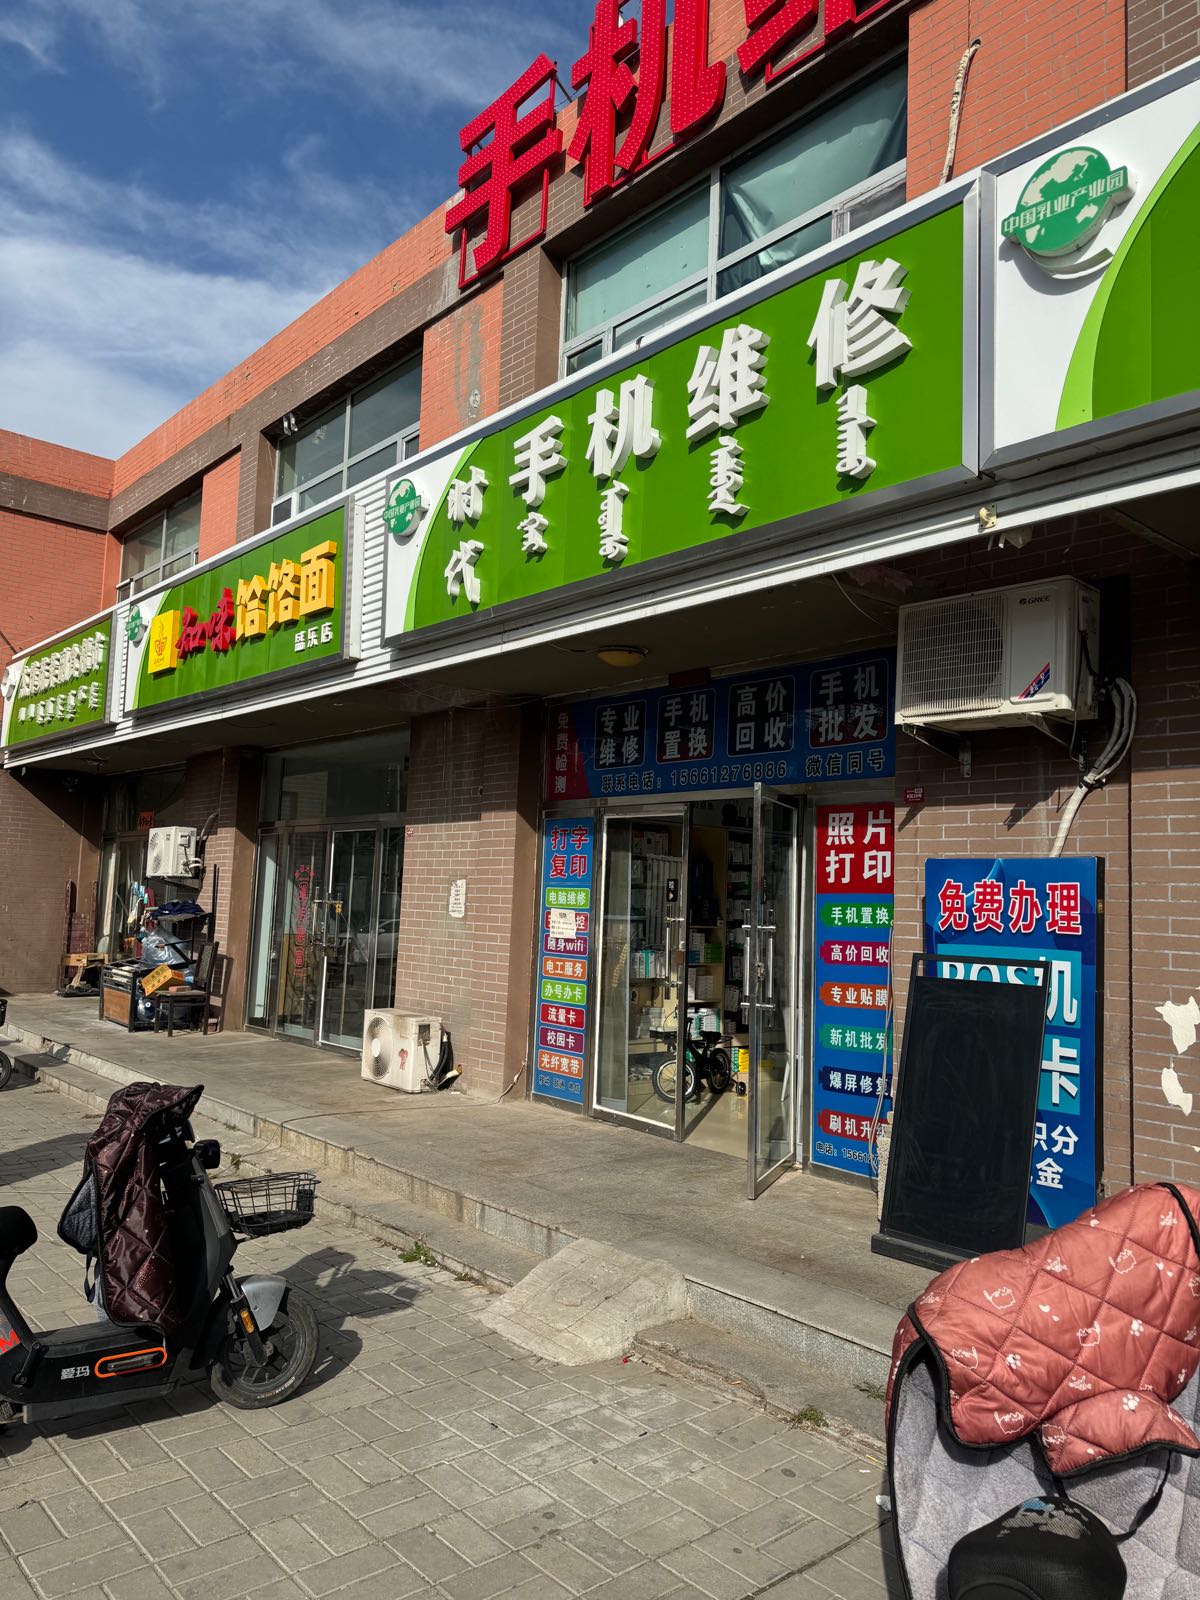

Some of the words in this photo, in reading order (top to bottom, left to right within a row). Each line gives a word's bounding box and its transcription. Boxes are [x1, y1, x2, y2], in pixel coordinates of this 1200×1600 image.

[1003, 170, 1124, 233] 中国乳业产业园
[508, 257, 913, 508] 手机维修
[444, 465, 490, 604] 时代
[736, 681, 788, 717] 高价
[818, 665, 880, 705] 手机
[601, 706, 640, 735] 专业
[664, 694, 709, 728] 手机
[818, 704, 879, 743] 批发
[663, 726, 709, 760] 置换
[735, 717, 787, 751] 回收
[553, 712, 570, 794] 免费检测
[599, 735, 640, 767] 维修
[805, 748, 886, 777] 微信同号
[551, 825, 589, 850] 打字
[826, 811, 893, 846] 照片
[550, 853, 588, 879] 复印
[826, 849, 893, 885] 打印
[548, 890, 587, 906] 电脑维修
[938, 879, 1083, 936] 免费办理
[830, 906, 889, 927] 手机置换
[547, 936, 584, 952] 随身wifi
[830, 944, 889, 964] 高价回收
[546, 960, 584, 978] 电工服务
[545, 982, 583, 1002] 办号办卡
[830, 985, 889, 1007] 专业贴膜
[547, 1007, 577, 1025] 流量卡
[547, 1031, 576, 1049] 校园卡
[829, 1027, 888, 1051] 新机批发
[541, 1053, 580, 1074] 光纤宽带
